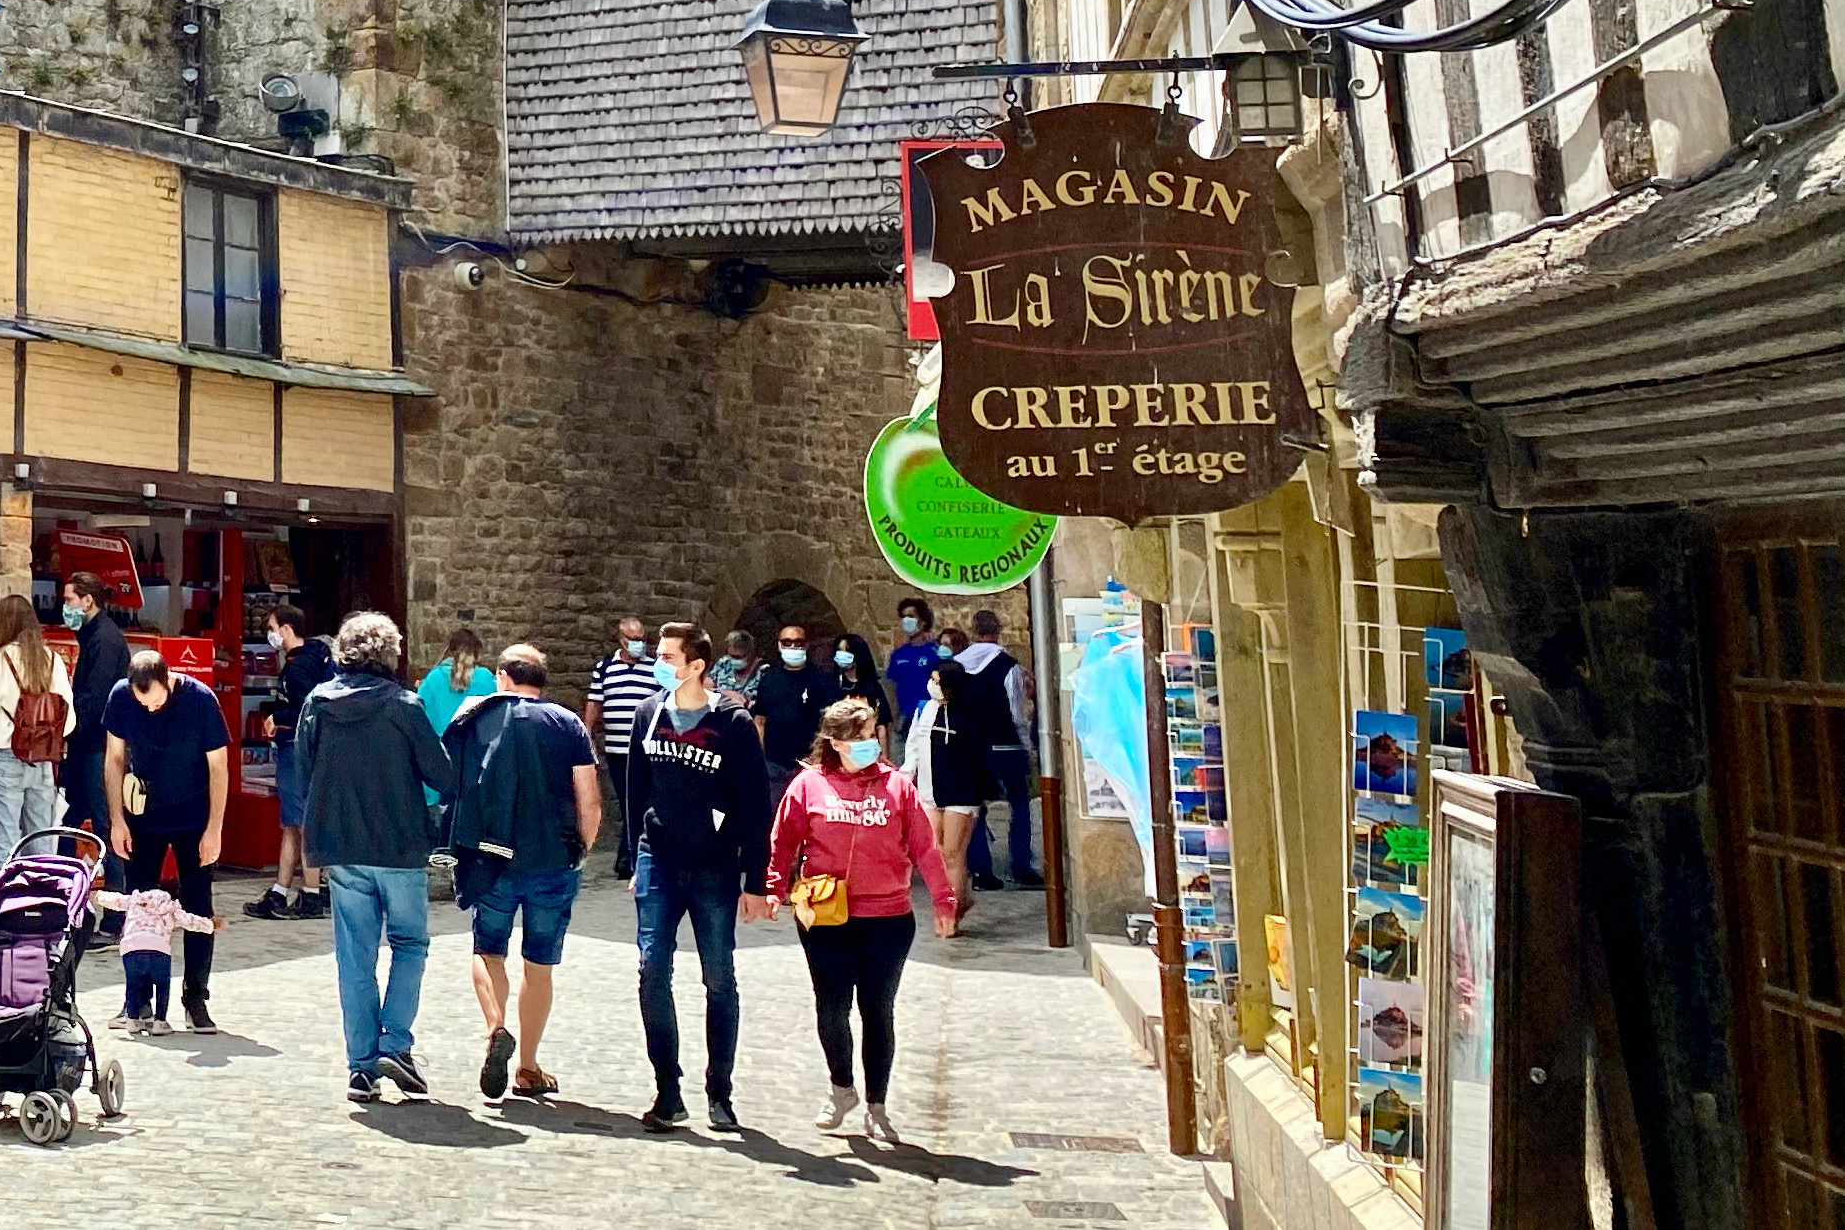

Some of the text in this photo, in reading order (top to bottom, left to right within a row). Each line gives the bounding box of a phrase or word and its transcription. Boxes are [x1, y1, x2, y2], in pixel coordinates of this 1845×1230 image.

[960, 168, 1251, 232] MAGASIN
[960, 250, 1266, 345] La Sirène
[971, 380, 1277, 430] CREPERIE
[1006, 454, 1058, 478] au
[1132, 444, 1247, 484] étage
[916, 500, 1006, 515] CONFISERIE
[878, 514, 1050, 583] PRODUITS REGIONAUX
[824, 794, 887, 812] Beverly
